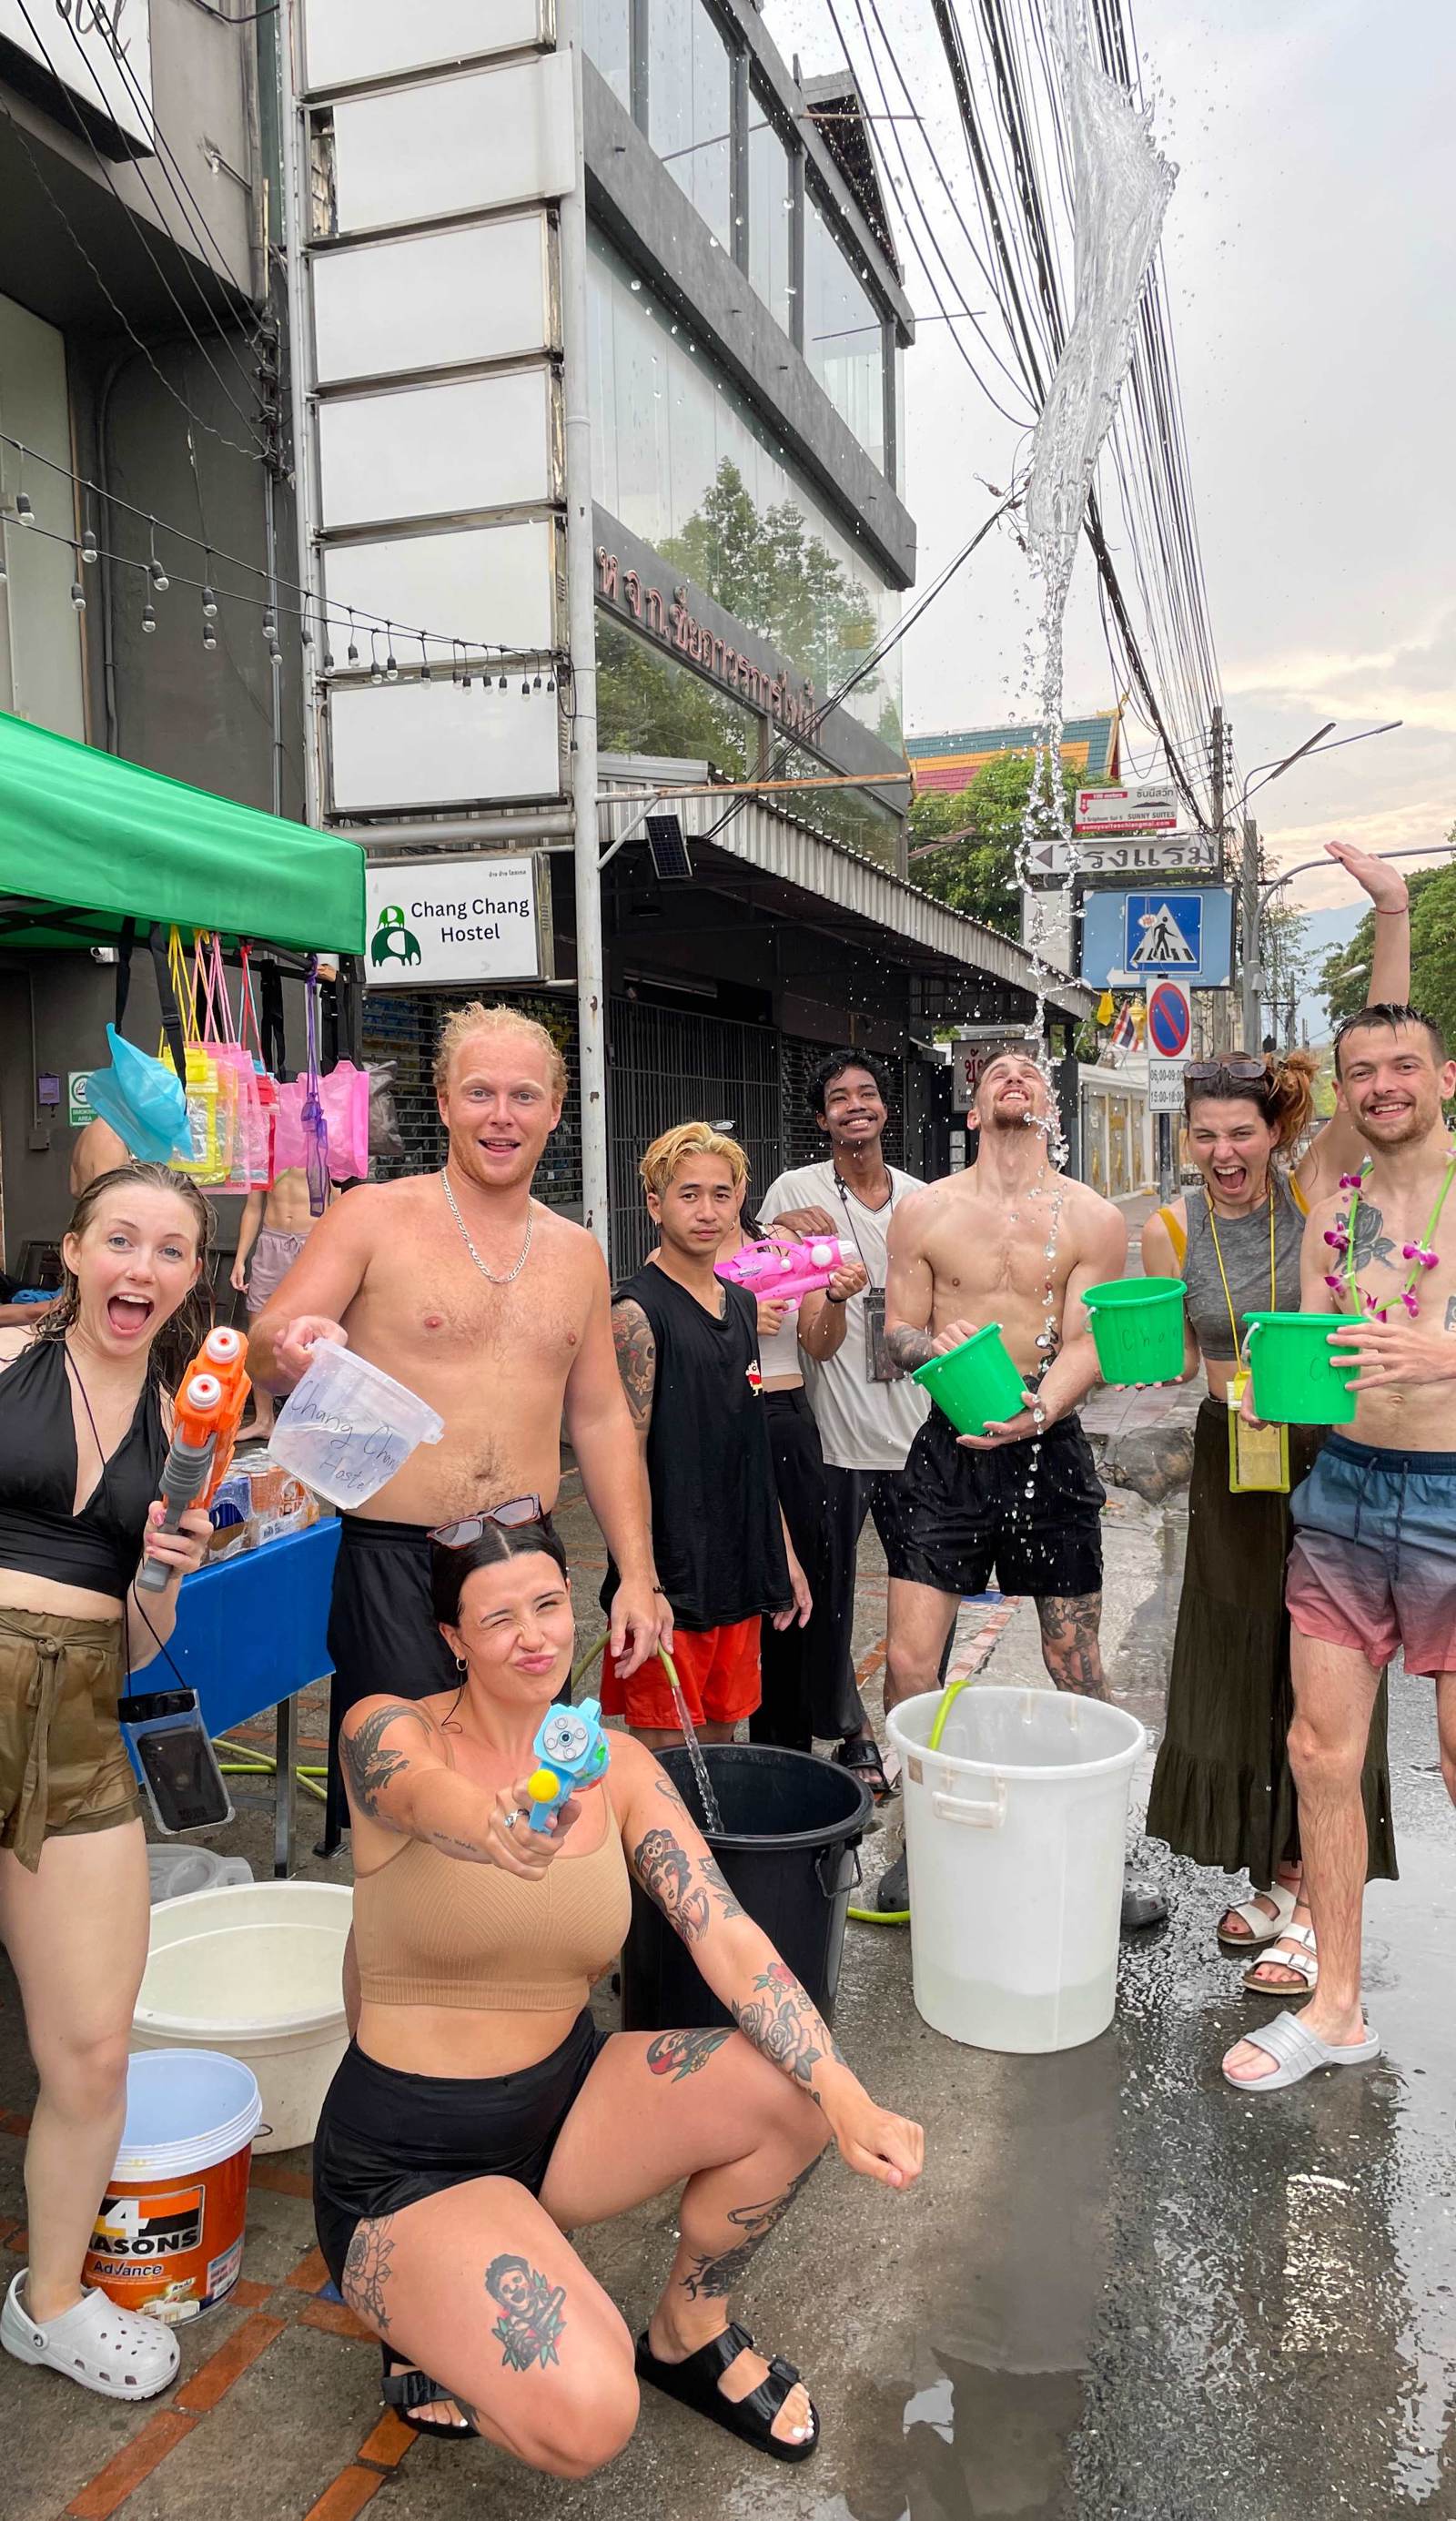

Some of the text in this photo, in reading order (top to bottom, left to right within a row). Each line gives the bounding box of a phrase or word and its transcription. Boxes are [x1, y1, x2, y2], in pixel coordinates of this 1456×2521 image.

[1127, 810, 1175, 821] SUNNY SUITES
[410, 897, 530, 920] Chang Chang
[440, 923, 500, 943] Hostel
[290, 1380, 353, 1450] Chang
[105, 2199, 150, 2238] 4
[89, 2229, 197, 2255] ASONS
